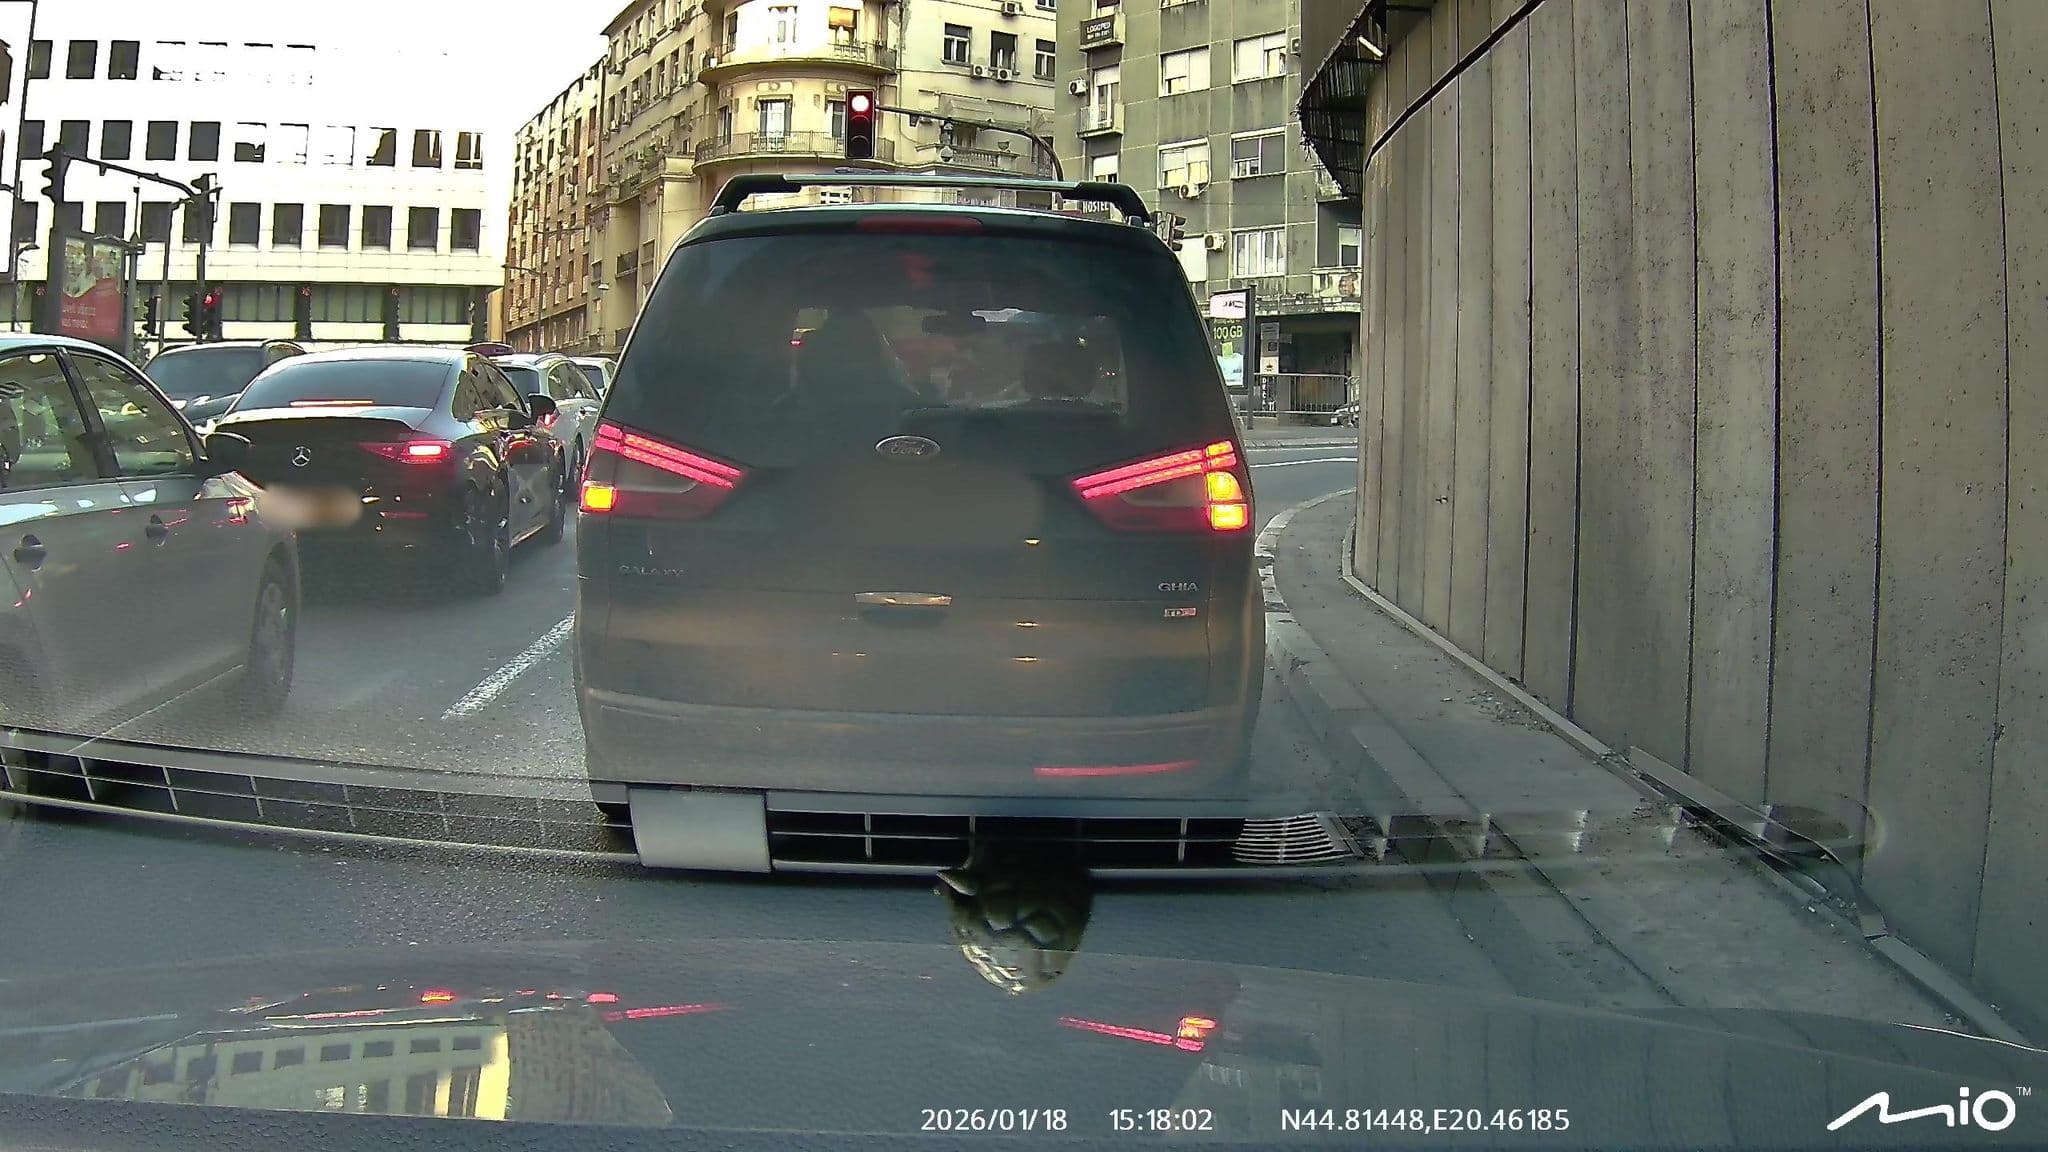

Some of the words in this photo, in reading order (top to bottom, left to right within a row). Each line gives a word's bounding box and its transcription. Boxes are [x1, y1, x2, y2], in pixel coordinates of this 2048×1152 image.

[1086, 21, 1111, 34] LOGOPED
[1082, 200, 1109, 214] HOSTEL
[1213, 326, 1229, 340] 100
[1229, 325, 1243, 339] GB
[1158, 582, 1198, 592] GHIA
